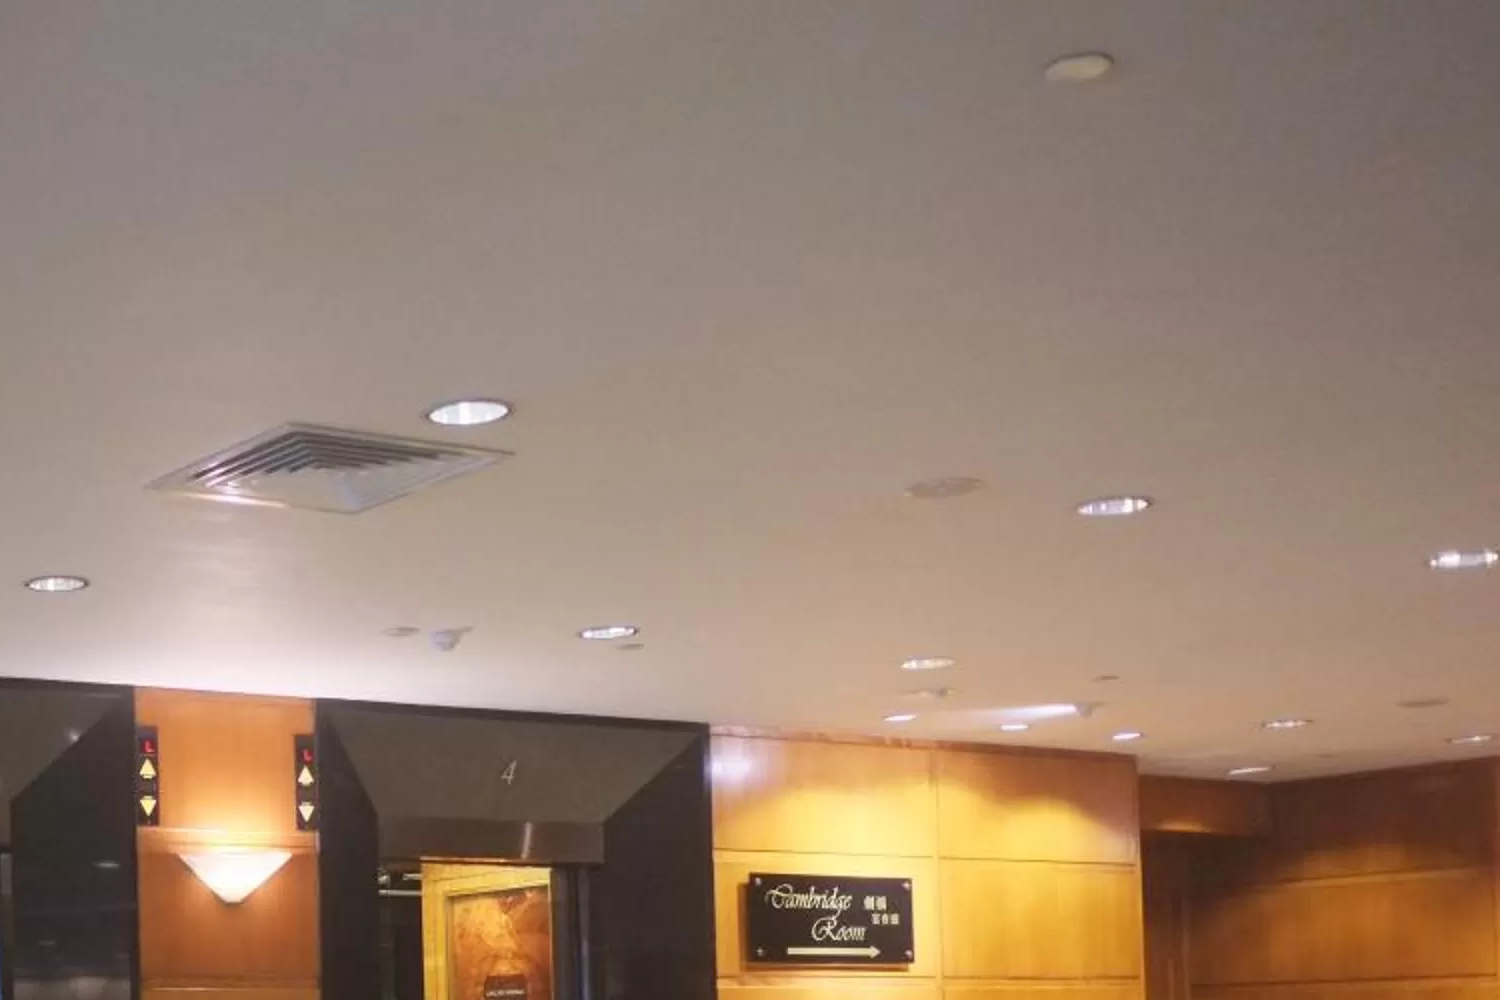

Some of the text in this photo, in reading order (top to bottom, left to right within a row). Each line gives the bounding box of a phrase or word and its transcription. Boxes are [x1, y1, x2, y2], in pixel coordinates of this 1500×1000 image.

[500, 759, 517, 785] 4
[765, 883, 853, 919] Cambridge
[811, 917, 866, 941] Room
